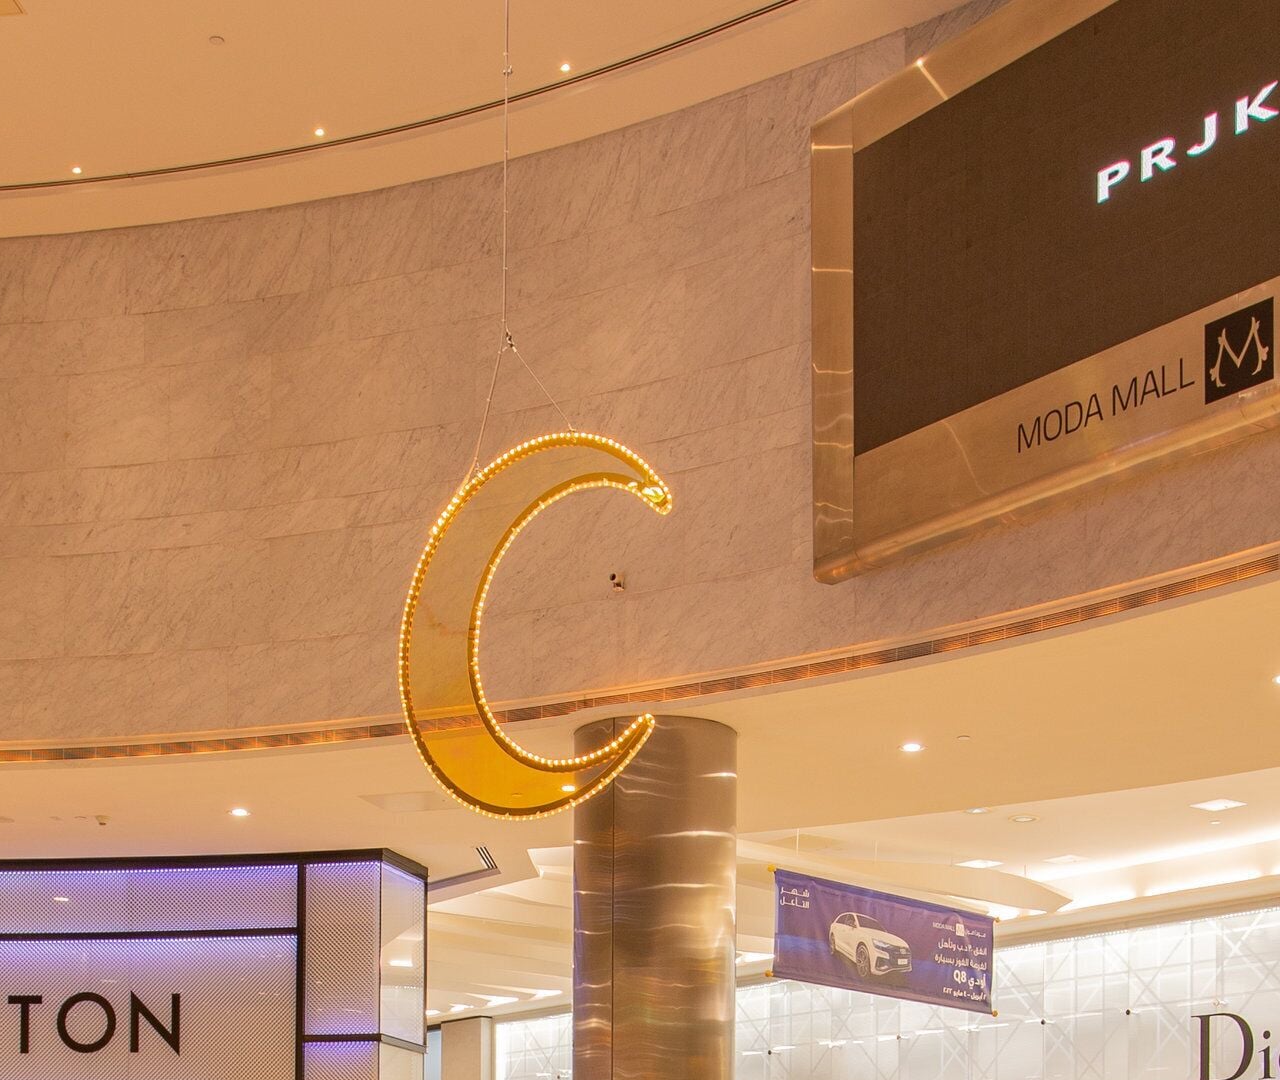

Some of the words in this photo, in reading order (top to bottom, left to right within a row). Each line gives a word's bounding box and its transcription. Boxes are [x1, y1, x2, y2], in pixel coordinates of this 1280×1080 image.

[1017, 393, 1104, 453] MODA
[1111, 358, 1196, 417] MALL
[953, 969, 967, 984] Q8
